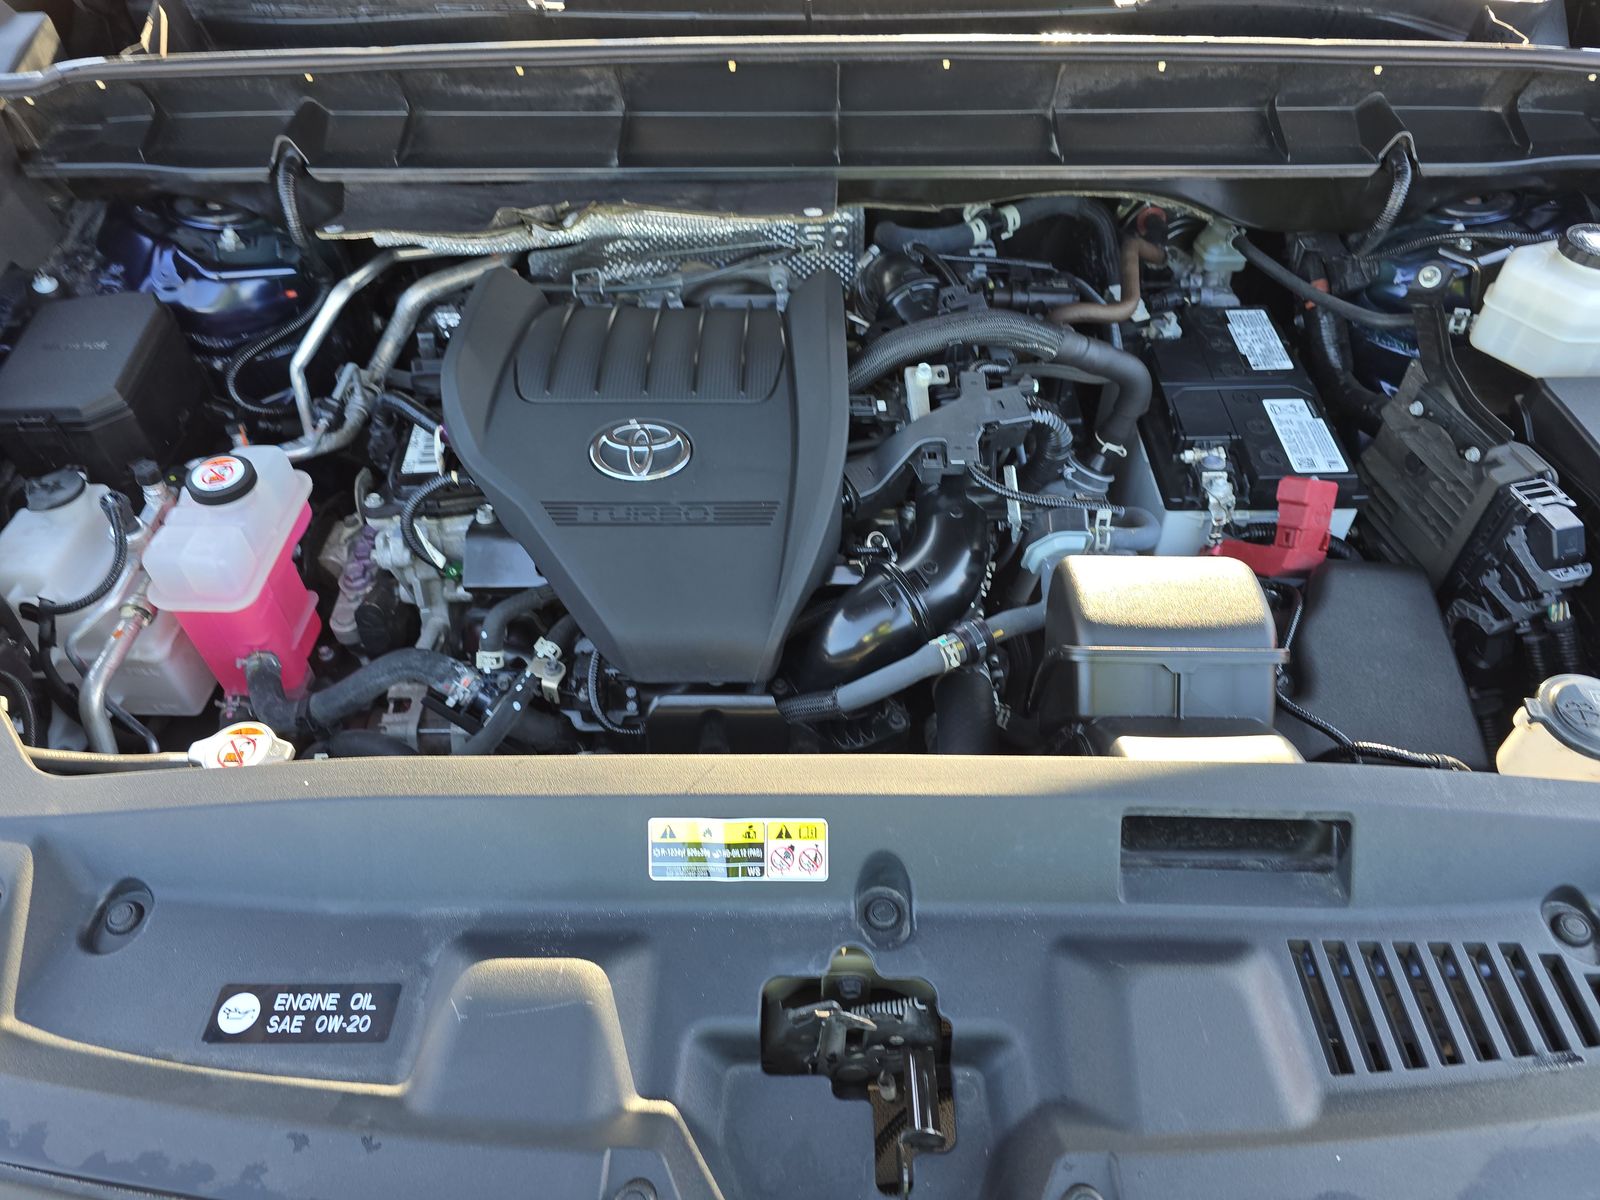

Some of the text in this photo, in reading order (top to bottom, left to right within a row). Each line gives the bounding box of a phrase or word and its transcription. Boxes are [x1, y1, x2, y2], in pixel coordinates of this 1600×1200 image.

[583, 506, 711, 522] TURBO
[274, 993, 376, 1011] ENGINE OIL
[266, 1015, 371, 1033] SAE 0W-20
